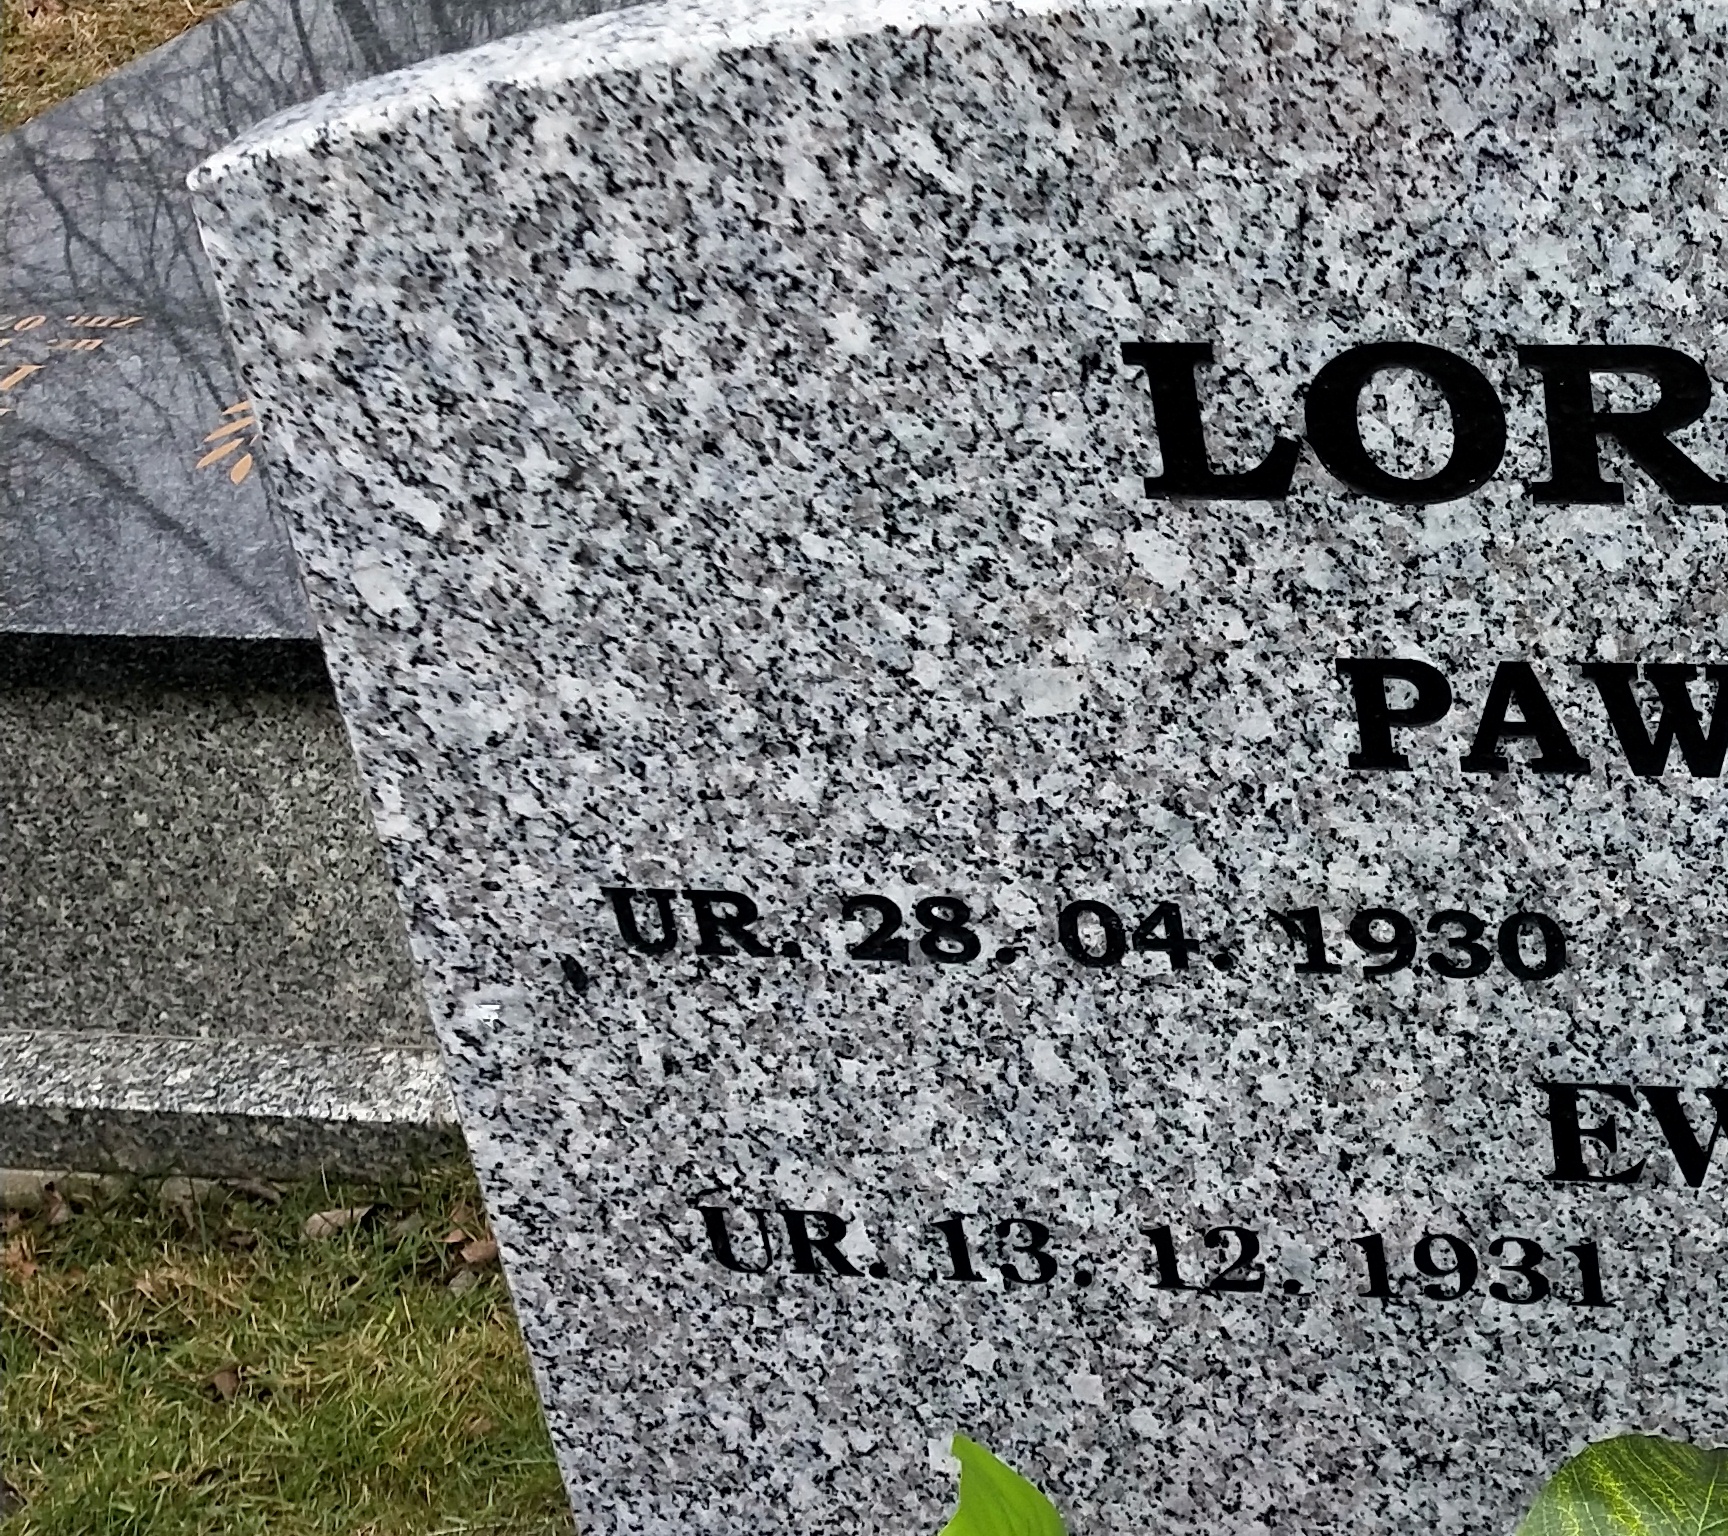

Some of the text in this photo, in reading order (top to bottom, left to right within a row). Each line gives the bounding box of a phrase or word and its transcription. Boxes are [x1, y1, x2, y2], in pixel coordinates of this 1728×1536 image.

[600, 886, 801, 959] UR.
[842, 894, 1018, 965] 28.
[1058, 899, 1234, 972] 04.
[1267, 906, 1568, 981] 1930
[699, 1205, 888, 1279] UR.
[929, 1218, 1094, 1288] 13.
[1140, 1224, 1303, 1295] 12.
[1351, 1231, 1616, 1307] 1931
